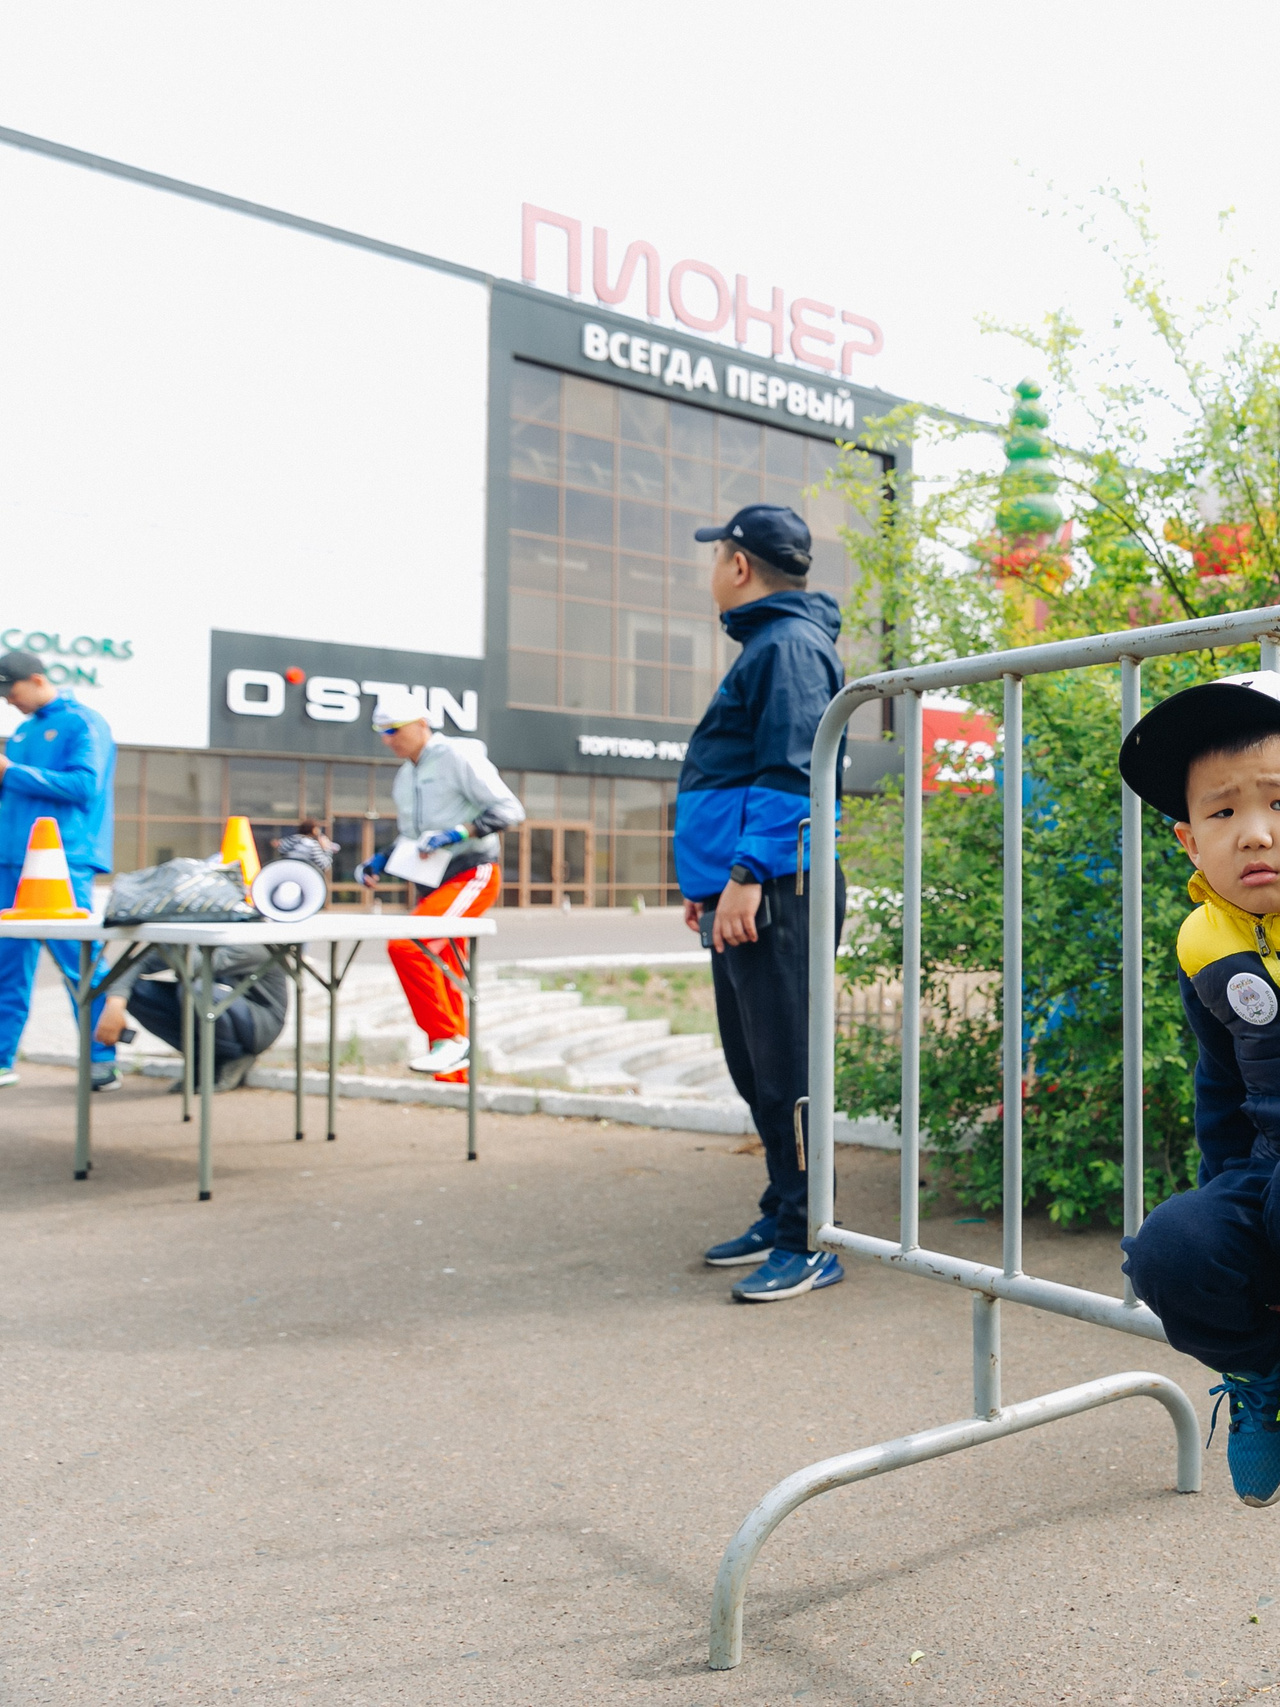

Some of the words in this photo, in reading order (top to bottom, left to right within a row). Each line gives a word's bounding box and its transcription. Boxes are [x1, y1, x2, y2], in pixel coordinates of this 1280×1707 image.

[521, 202, 884, 376] ПИОНЕР
[582, 323, 719, 393] ВСЕГДА
[726, 364, 855, 430] ПЕРВЫЙ
[1, 629, 134, 659] COLORS
